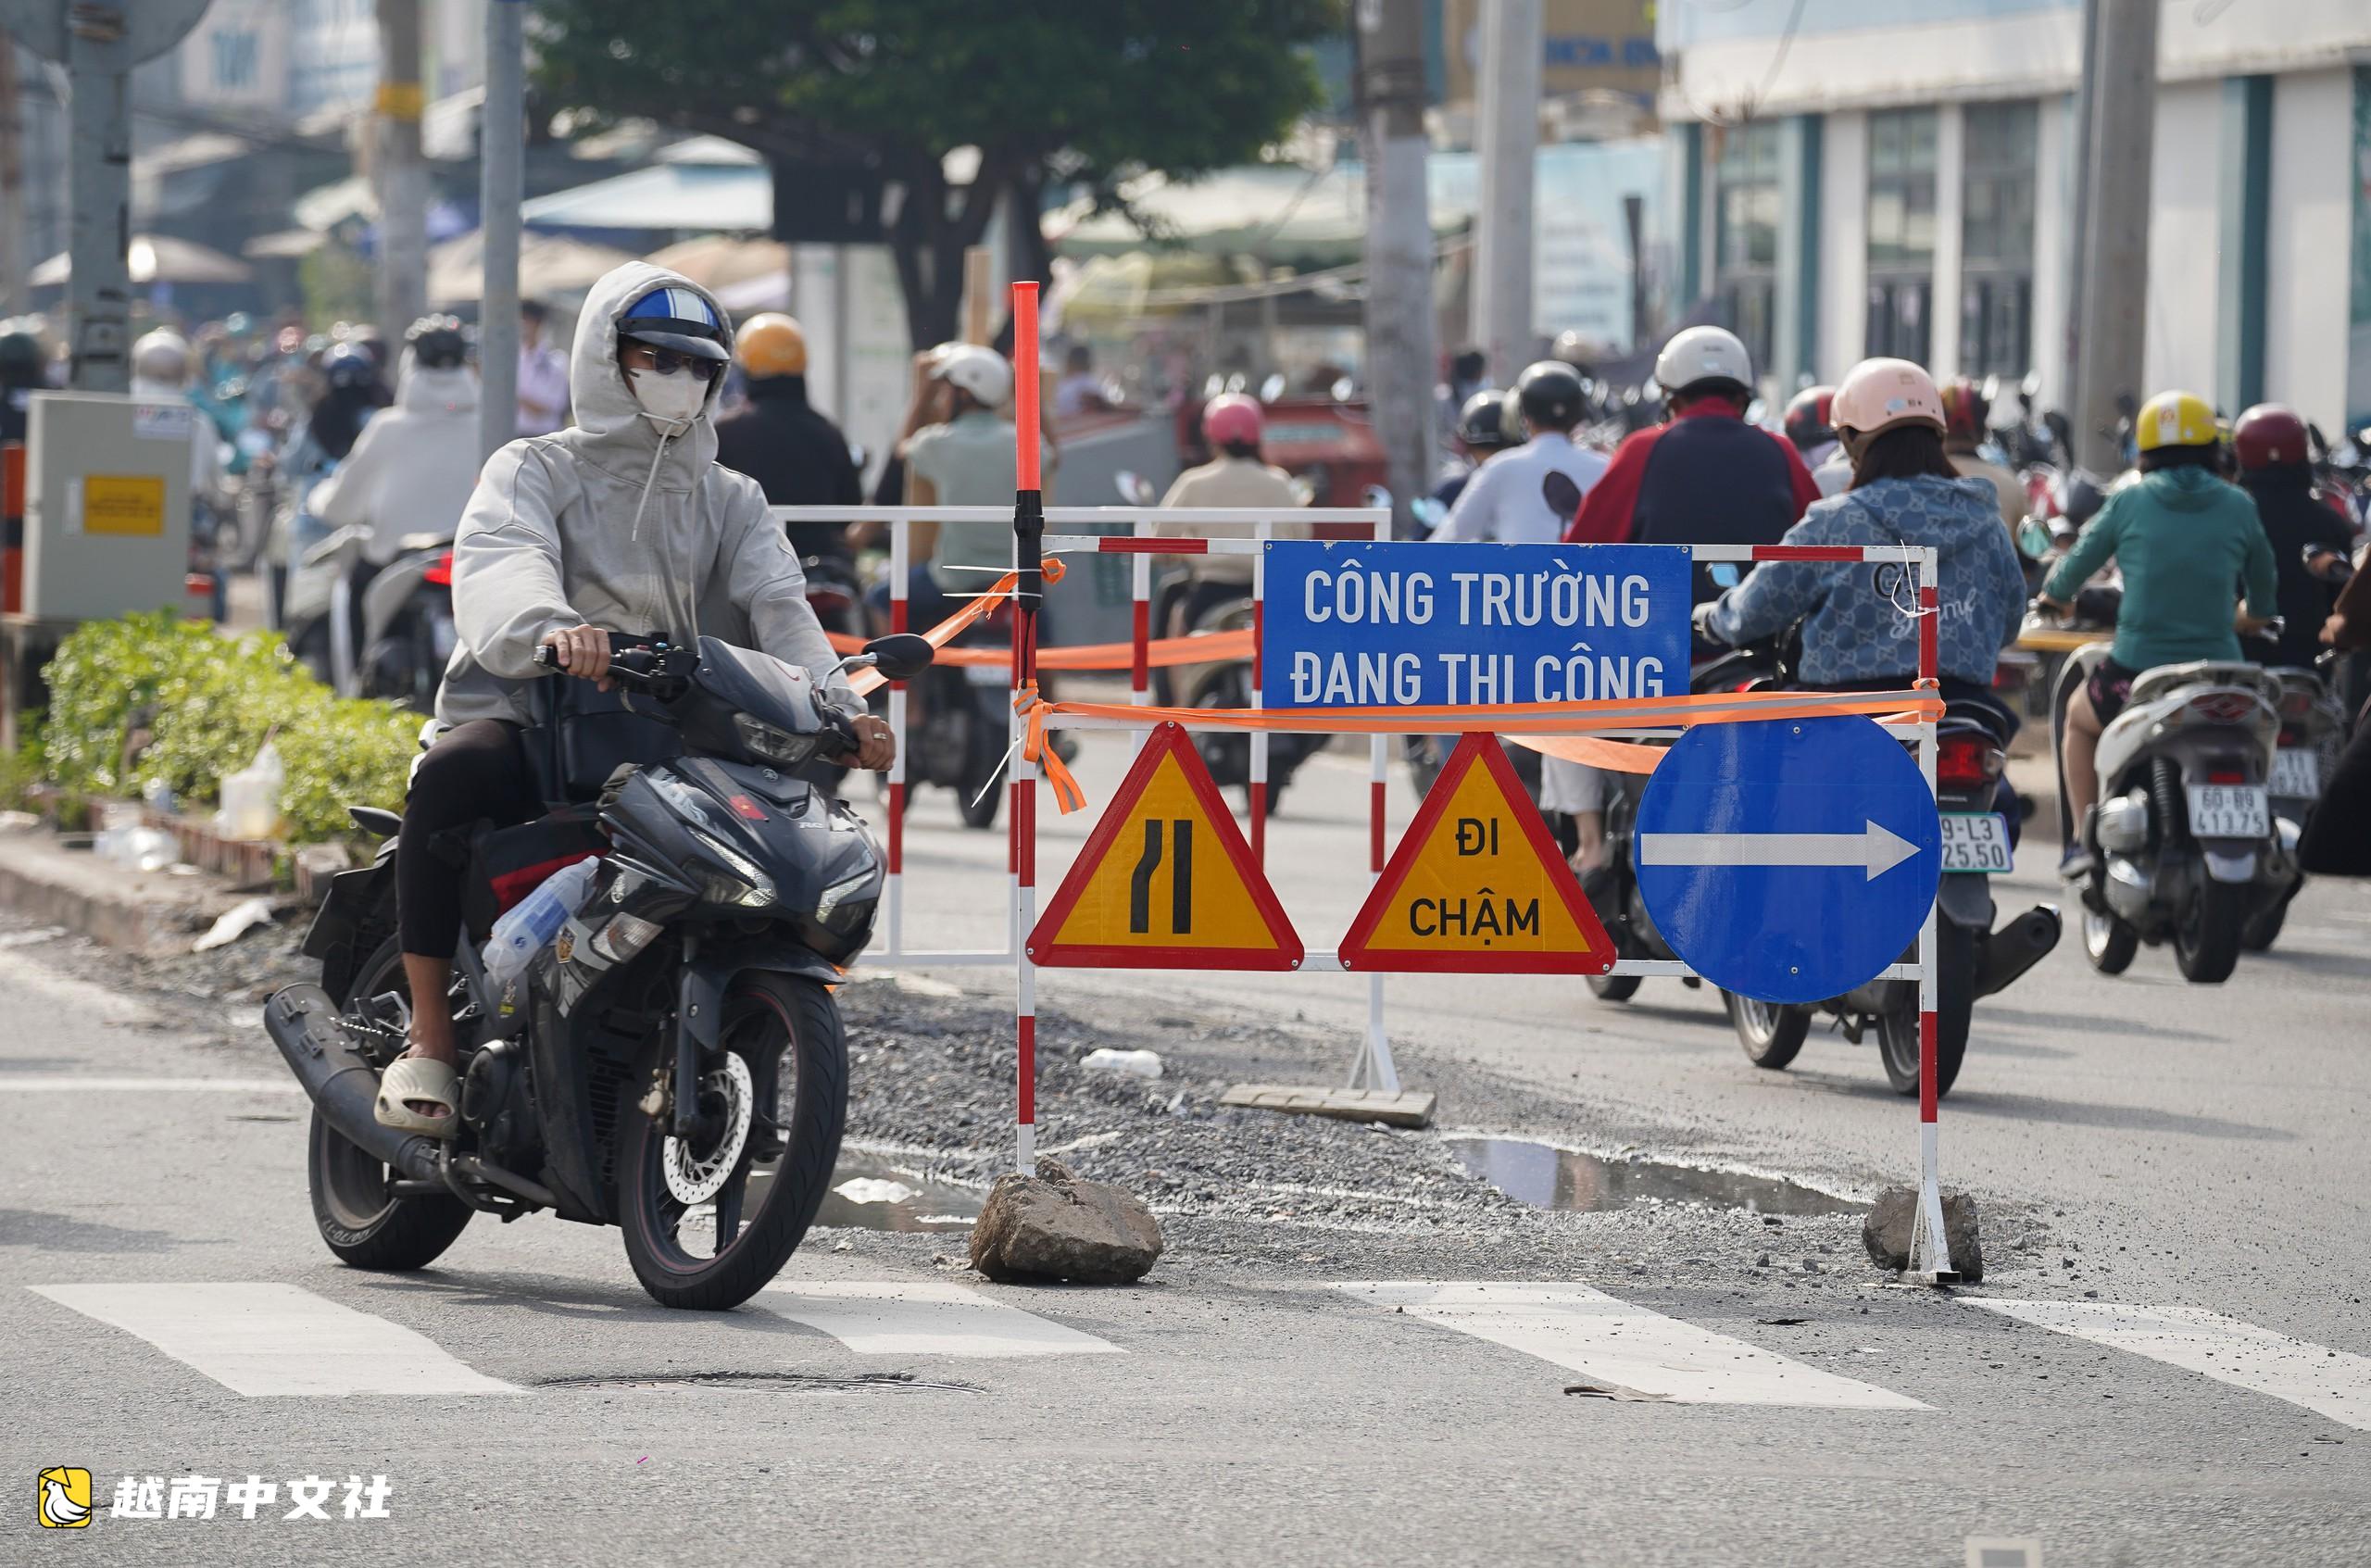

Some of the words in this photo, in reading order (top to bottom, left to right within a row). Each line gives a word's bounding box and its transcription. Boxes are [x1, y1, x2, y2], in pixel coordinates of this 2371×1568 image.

[1304, 558, 1434, 625] CÔNG
[1451, 558, 1650, 628] TRƯỜNG
[1289, 651, 1422, 706] ĐANG
[1438, 654, 1514, 705] THI
[1535, 642, 1664, 704] CÔNG
[1455, 818, 1499, 856] ĐI
[1941, 818, 1993, 841] 9-L3
[1942, 842, 2004, 868] 25.50
[1410, 886, 1539, 946] CHẬM
